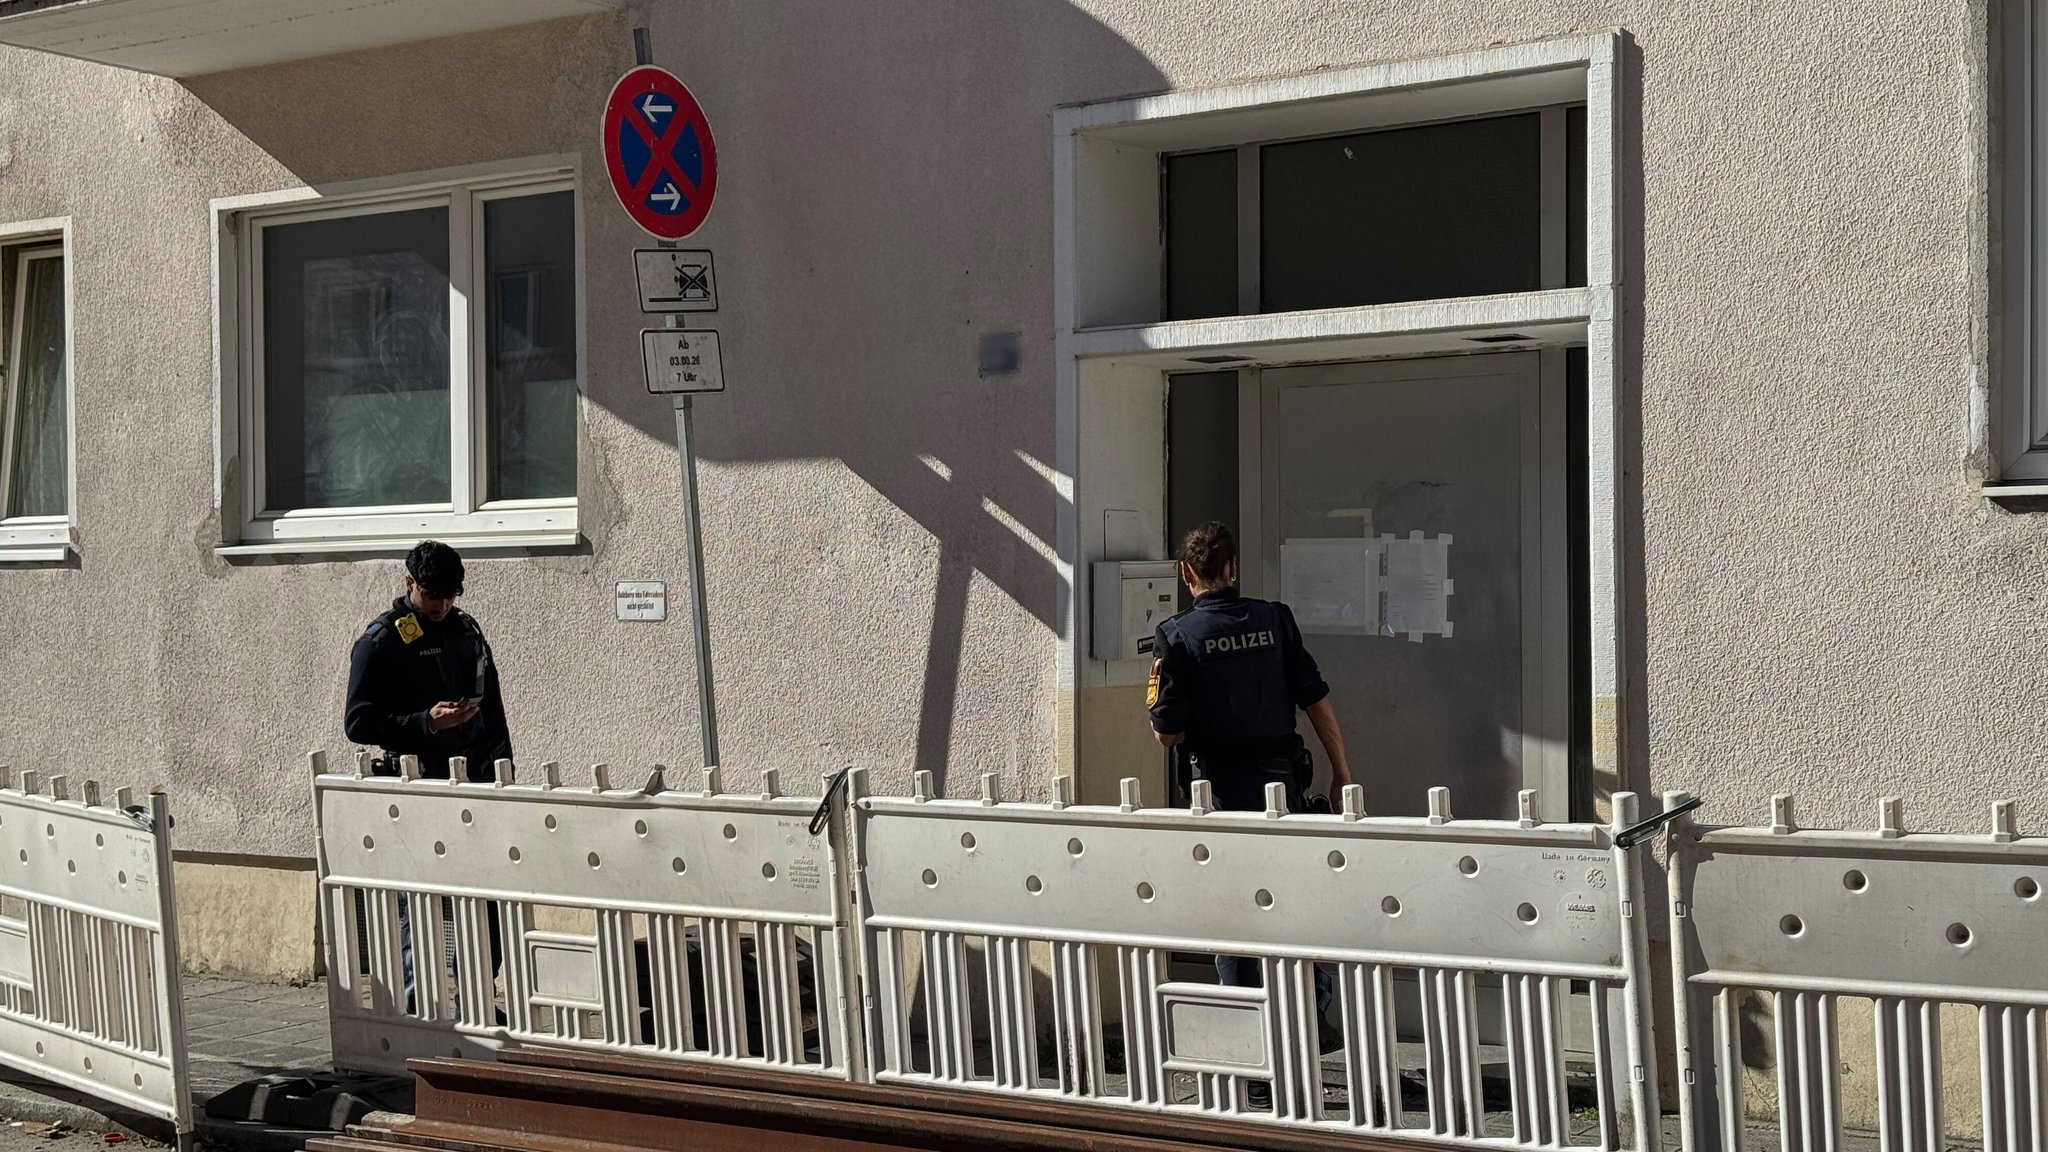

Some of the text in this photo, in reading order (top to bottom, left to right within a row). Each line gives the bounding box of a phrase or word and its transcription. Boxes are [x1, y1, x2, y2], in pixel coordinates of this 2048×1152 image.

[678, 336, 690, 350] Ab
[676, 372, 698, 383] 7 Uhr
[1204, 630, 1275, 654] POLIZEI
[419, 647, 442, 657] POLIZEI
[1577, 854, 1611, 864] Germany
